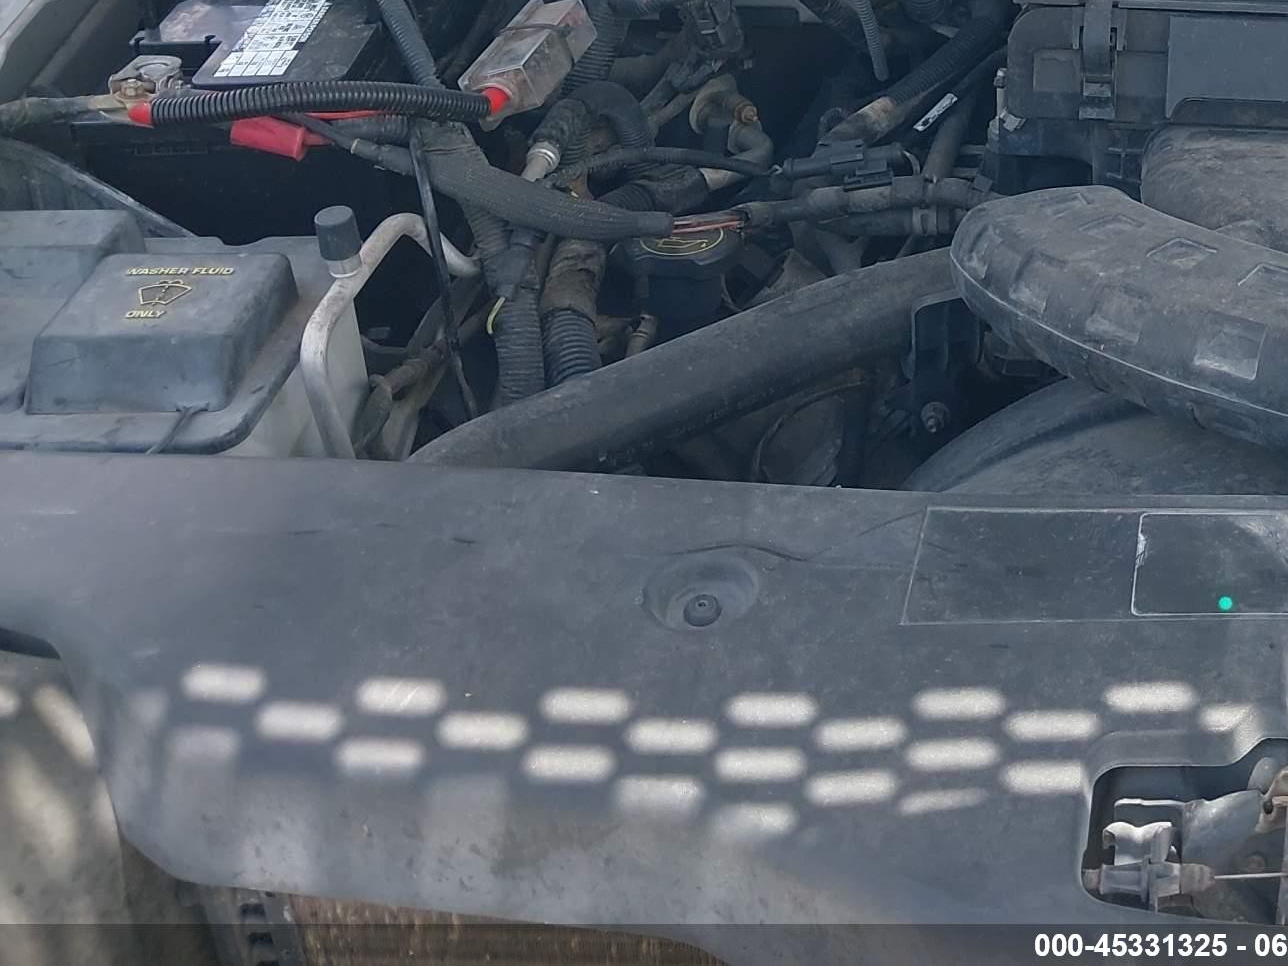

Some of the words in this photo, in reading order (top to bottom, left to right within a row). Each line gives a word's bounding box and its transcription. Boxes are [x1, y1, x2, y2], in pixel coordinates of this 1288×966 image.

[126, 267, 190, 276] WASHER
[191, 267, 235, 275] FLUID
[125, 310, 167, 319] ONLY
